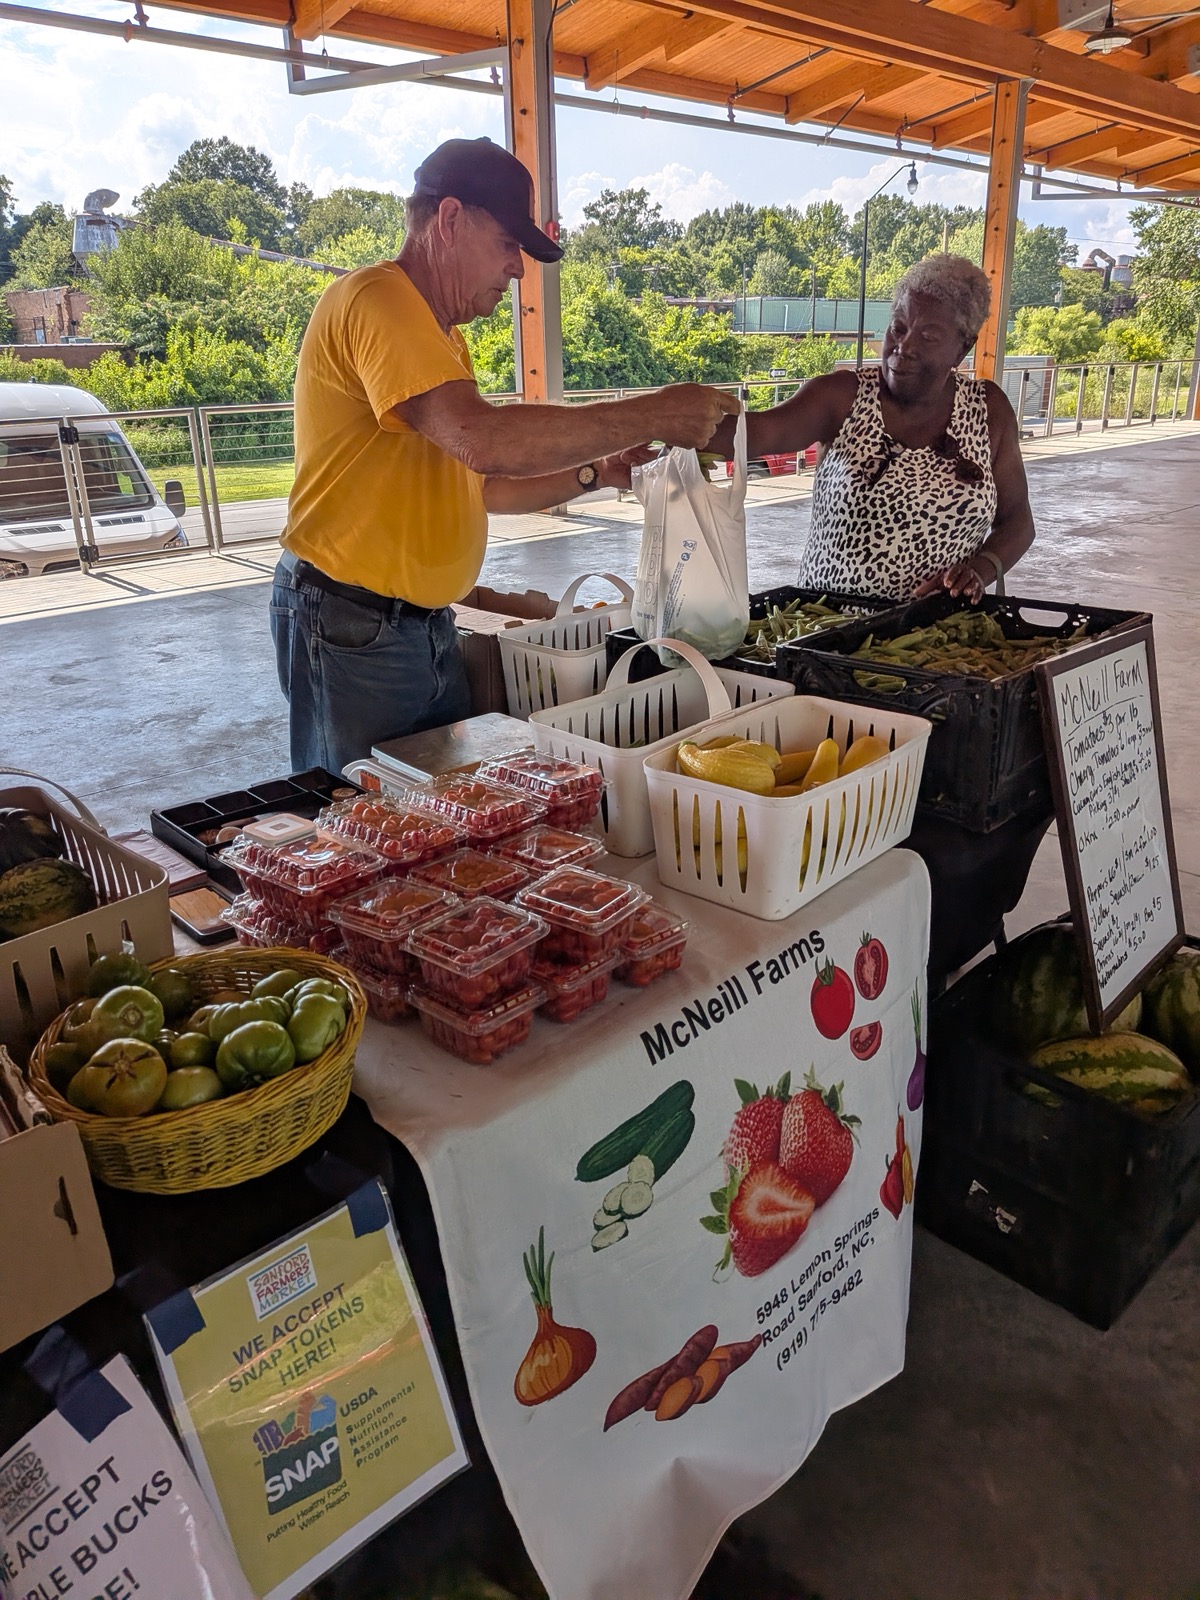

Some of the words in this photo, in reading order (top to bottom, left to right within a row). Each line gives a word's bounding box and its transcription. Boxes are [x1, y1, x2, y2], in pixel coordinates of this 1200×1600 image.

[1061, 664, 1109, 727] McNeill
[1113, 659, 1143, 692] Farm
[1064, 726, 1105, 766] Tomatoes
[640, 975, 748, 1066] McNeill
[745, 930, 825, 995] Farms
[756, 1288, 788, 1324] 5948
[790, 1250, 831, 1294] Lemon
[834, 1208, 879, 1252] Springs
[762, 1306, 795, 1348] Road
[798, 1254, 849, 1311] Sanford,
[852, 1232, 875, 1258] NC,
[229, 1348, 282, 1393] SNAP
[286, 1296, 365, 1354] TOKENS
[233, 1334, 267, 1365] WE
[272, 1282, 345, 1343] ACCEPT
[777, 1327, 808, 1371] (919)
[279, 1337, 336, 1386] HERE!
[340, 1387, 378, 1417] USDA
[346, 1381, 415, 1434] Supplemental
[349, 1411, 394, 1446] Nutrition
[353, 1416, 407, 1457] Assistance
[356, 1435, 399, 1468] Program
[265, 1436, 339, 1502] SNAP
[16, 1456, 120, 1568] ACCEPT
[70, 1470, 173, 1575] BUCKS
[266, 1518, 296, 1542] Putting
[326, 1480, 347, 1498] Food
[325, 1491, 350, 1511] Reach
